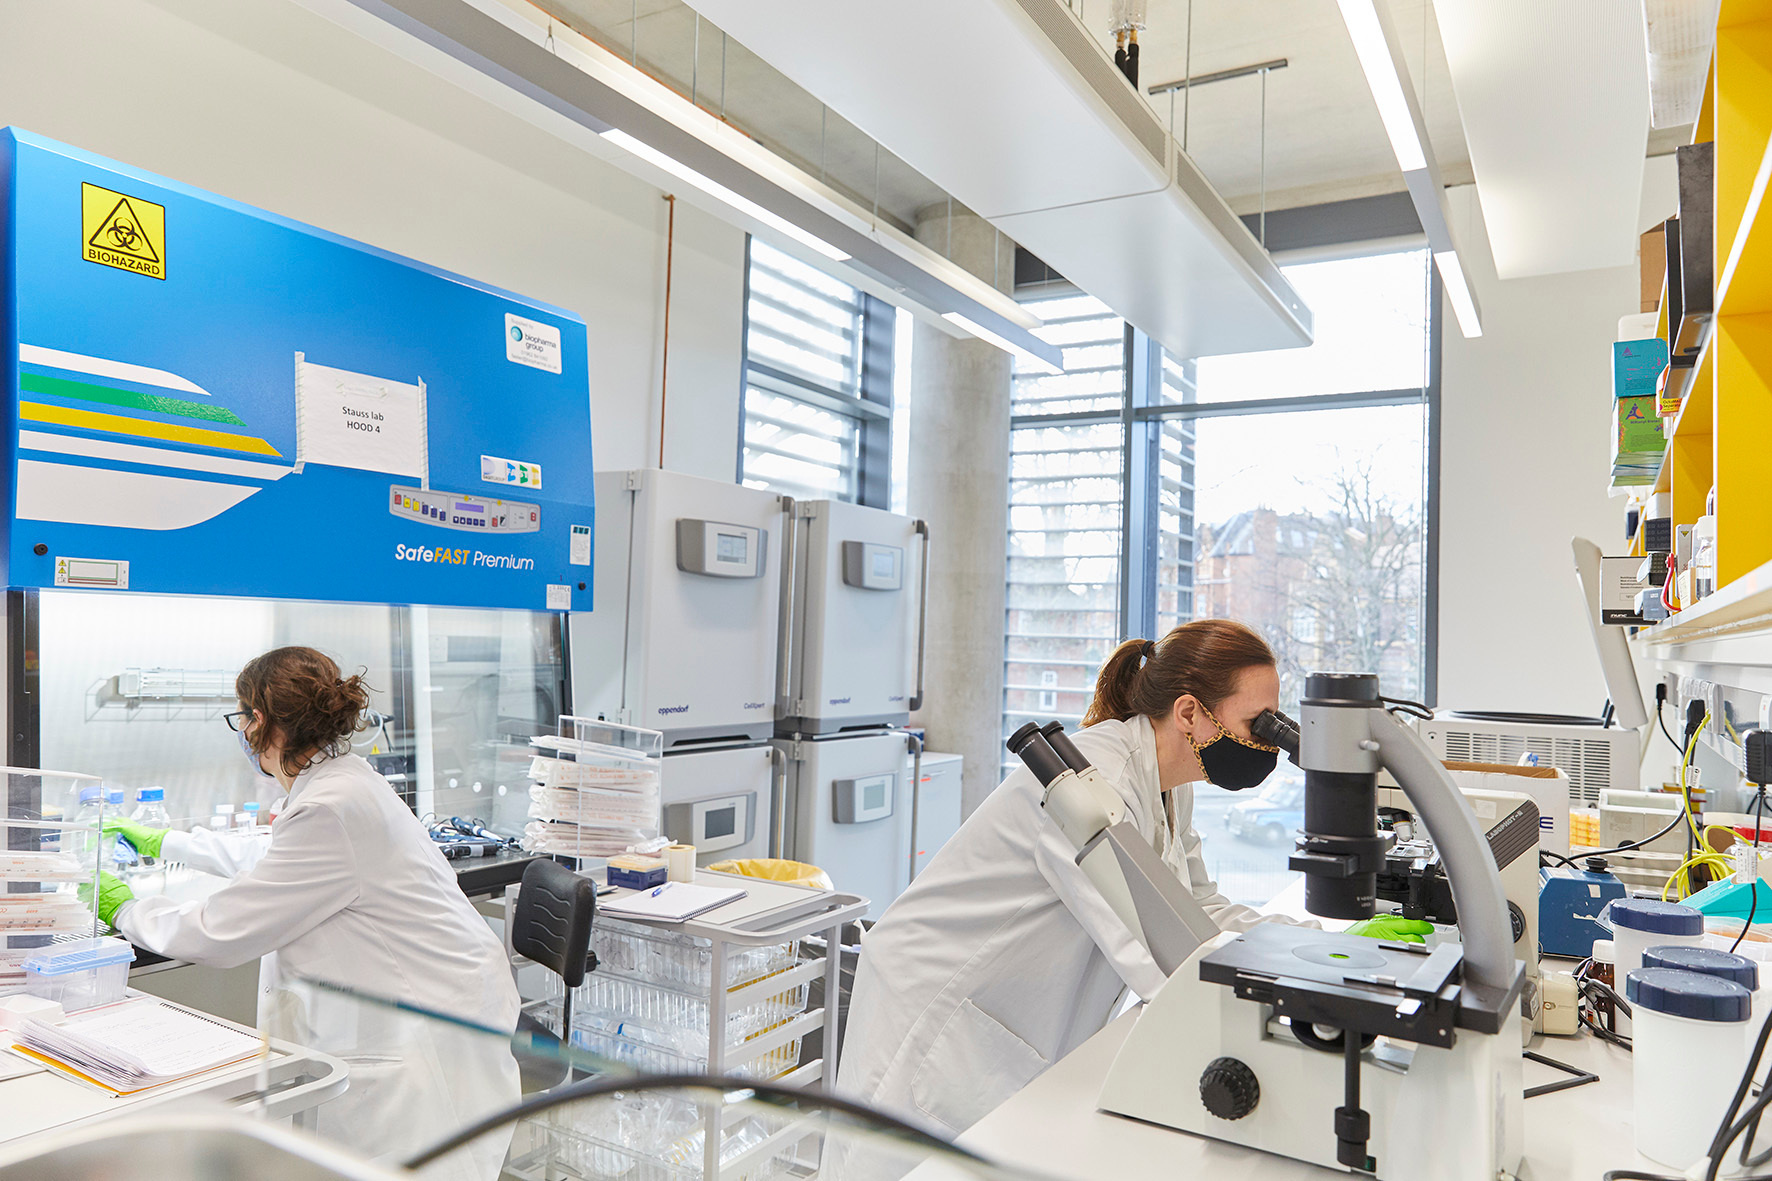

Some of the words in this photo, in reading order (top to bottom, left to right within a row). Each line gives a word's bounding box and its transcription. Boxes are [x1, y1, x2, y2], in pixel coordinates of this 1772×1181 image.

[88, 248, 160, 275] BIOHAZARD
[525, 333, 557, 349] biopharma
[525, 342, 544, 352] group
[342, 406, 370, 419] Stauss
[371, 411, 385, 421] lab
[346, 420, 374, 433] HOOD
[374, 425, 381, 433] 4
[473, 550, 534, 570] Premium
[658, 705, 689, 715] eppendorf
